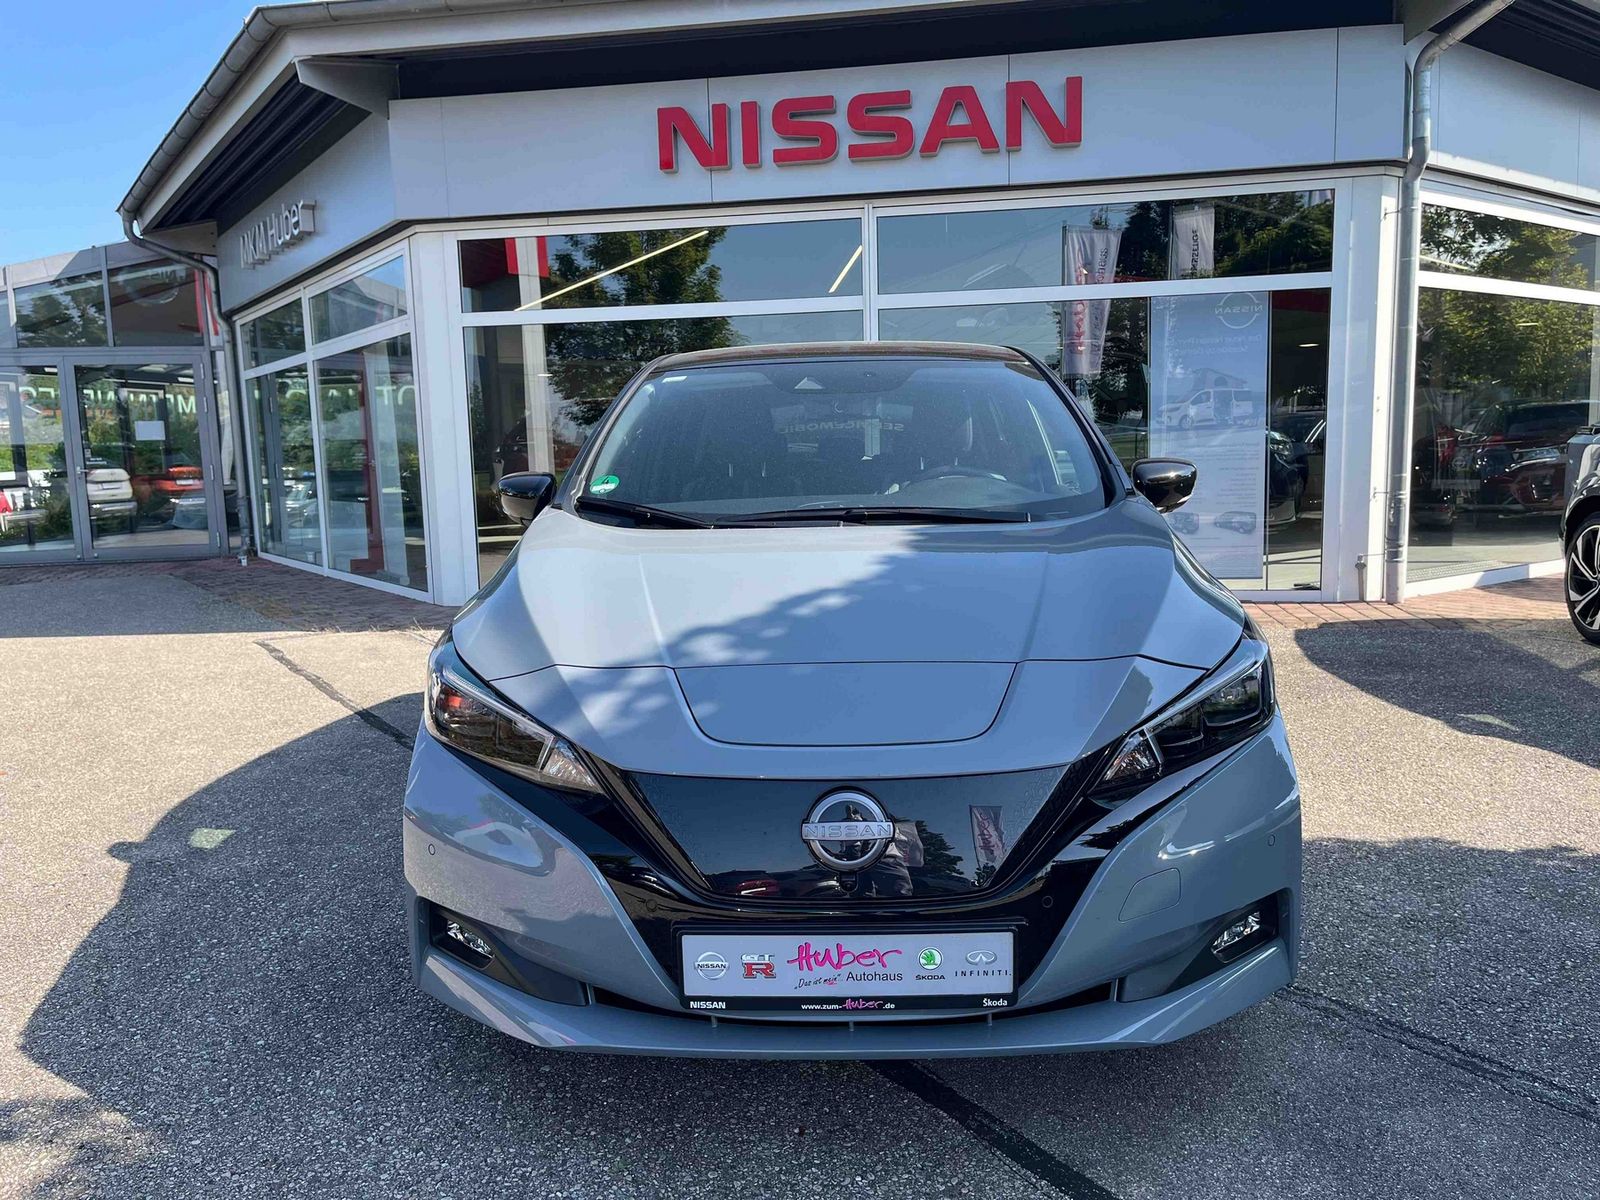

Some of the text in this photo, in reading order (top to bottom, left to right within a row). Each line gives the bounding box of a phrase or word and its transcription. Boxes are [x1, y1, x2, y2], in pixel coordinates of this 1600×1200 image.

[656, 75, 1084, 174] NISSAN
[266, 199, 304, 250] Huber
[804, 823, 892, 838] NISSAN
[786, 942, 903, 972] Huber
[846, 971, 903, 982] Autohaus
[689, 1001, 726, 1009] NISSAN
[982, 998, 1008, 1007] Škoda
